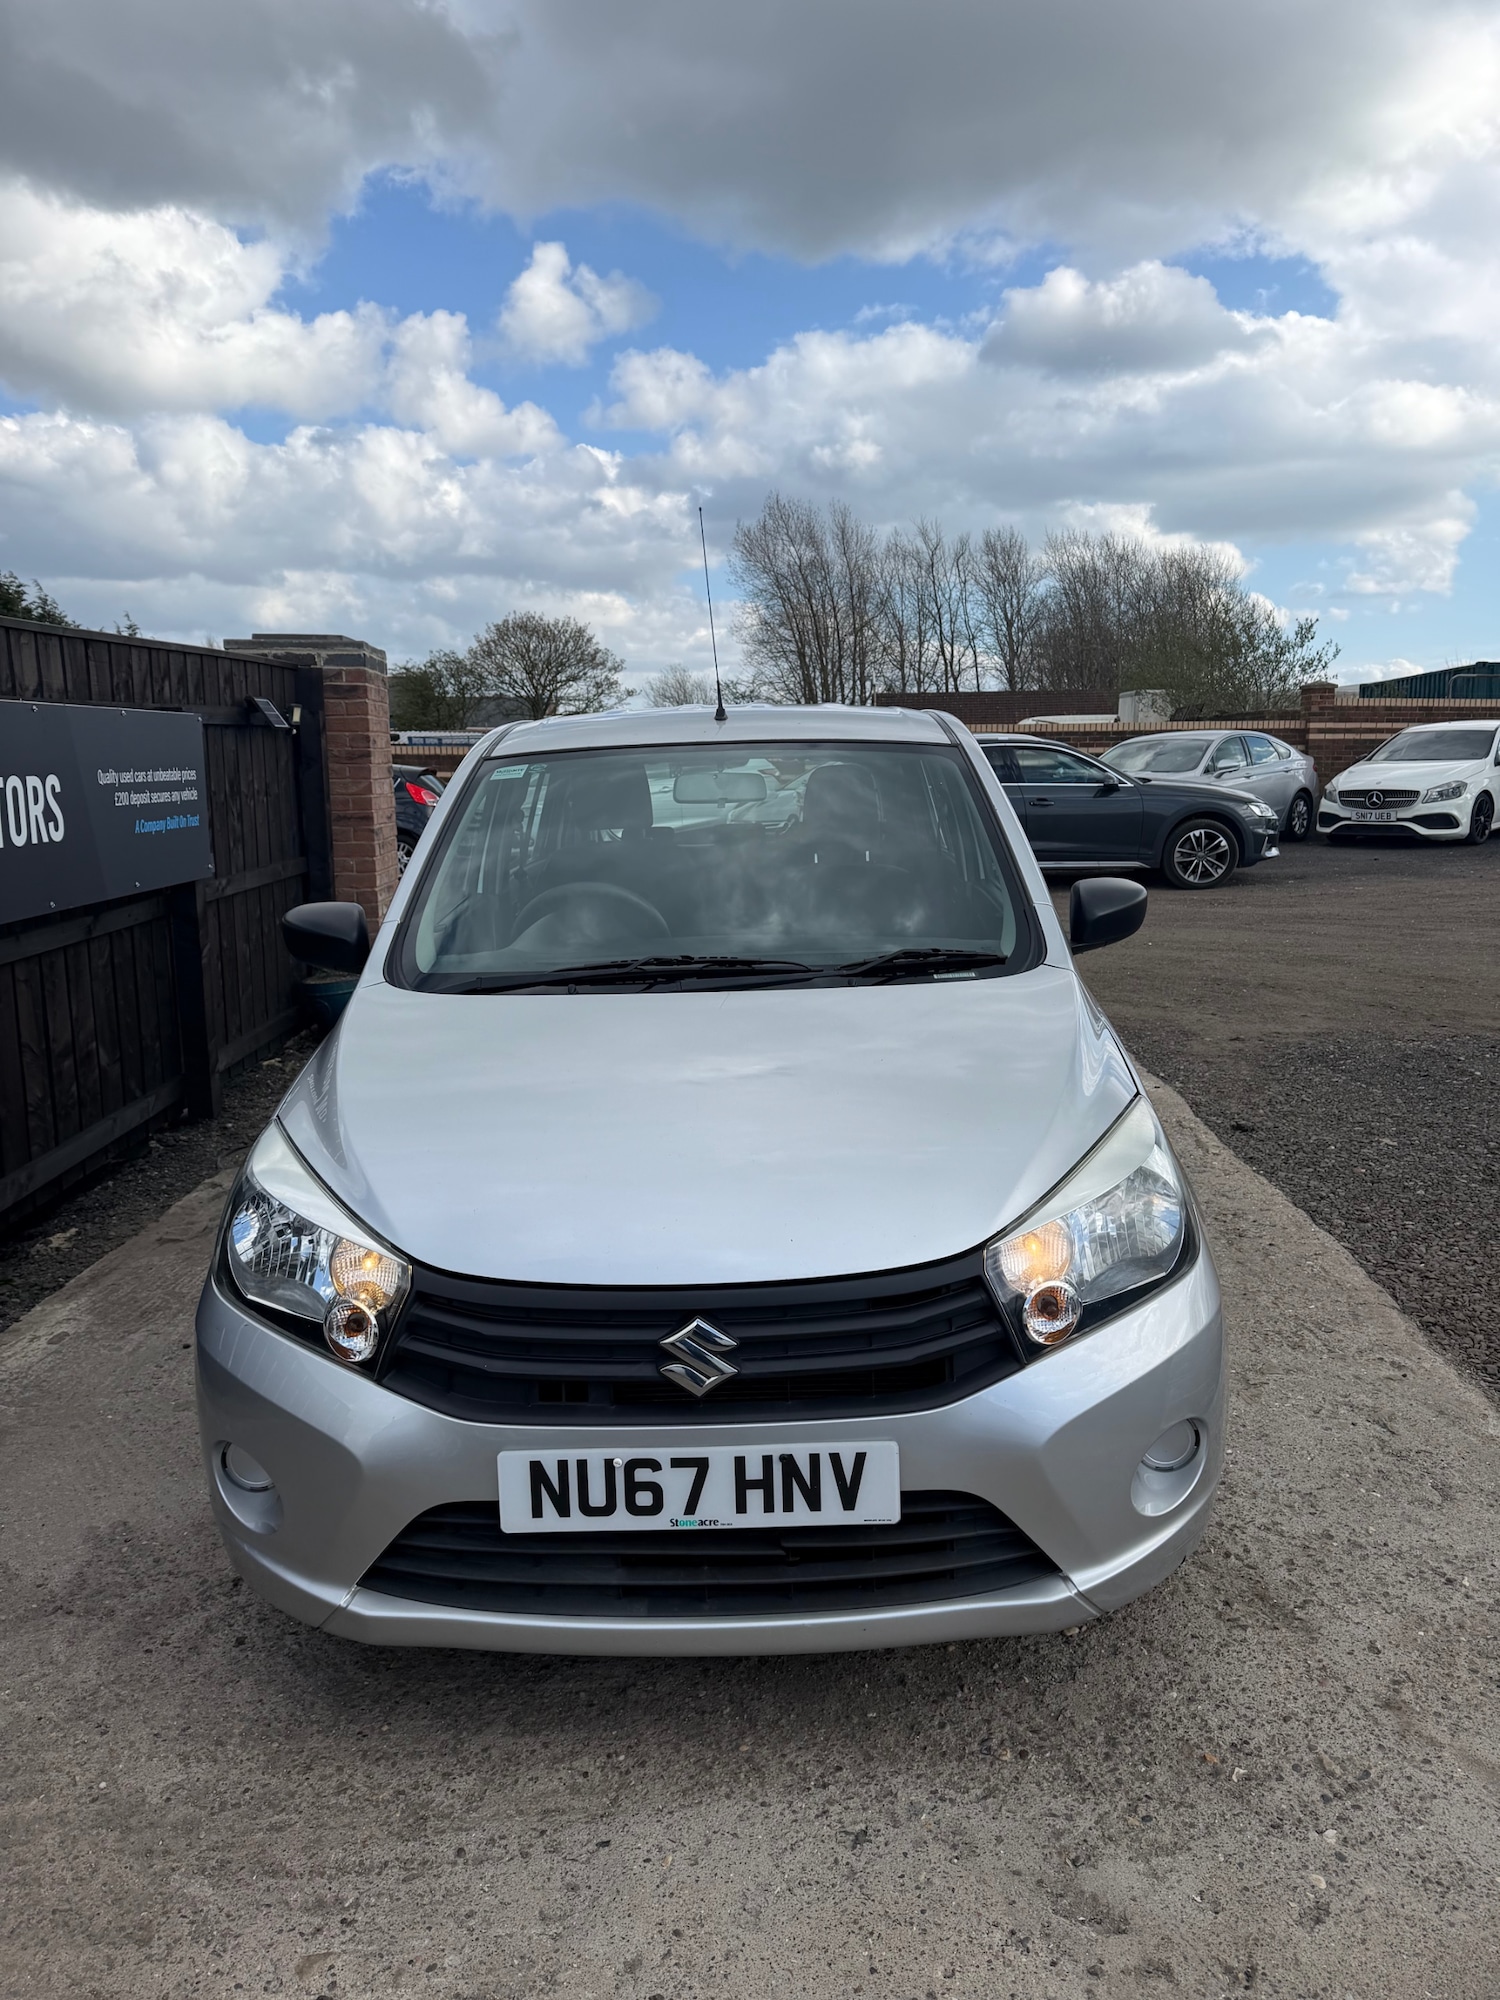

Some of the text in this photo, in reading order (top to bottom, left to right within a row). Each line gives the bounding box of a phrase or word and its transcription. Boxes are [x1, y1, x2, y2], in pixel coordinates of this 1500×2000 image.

[97, 767, 197, 787] Quality used cars at unbeatable prices
[114, 787, 198, 807] £200 deposit secures any vehicle
[0, 774, 65, 848] ORS
[1355, 811, 1392, 820] SN17 UEB
[134, 814, 200, 835] A Company Built On Trust
[528, 1451, 867, 1519] NU67 HNV
[669, 1518, 720, 1527] Stoneacre
